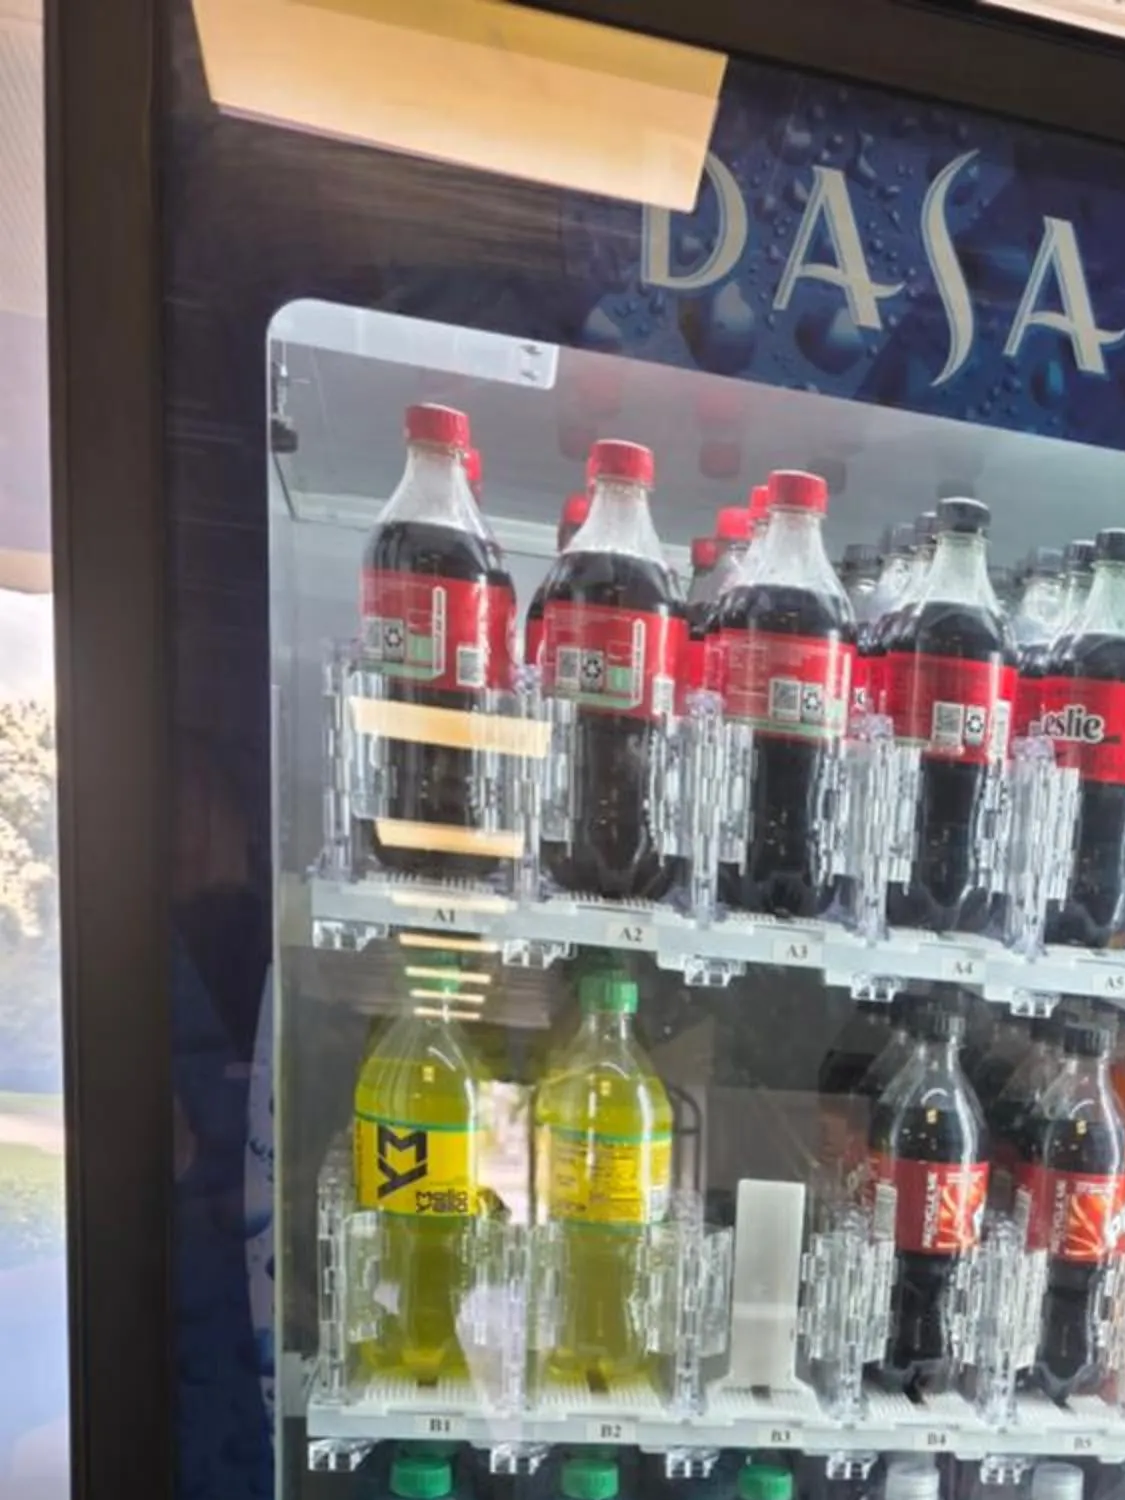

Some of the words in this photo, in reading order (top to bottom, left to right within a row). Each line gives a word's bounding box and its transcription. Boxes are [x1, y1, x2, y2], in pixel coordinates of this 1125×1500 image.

[1030, 704, 1105, 744] eslie
[433, 909, 455, 922] A1
[620, 930, 643, 942] A2
[786, 946, 807, 958] A3
[953, 962, 972, 974] A4
[1105, 976, 1124, 989] A5
[430, 1421, 450, 1432] B1
[601, 1426, 621, 1437] B2
[771, 1432, 790, 1442] B3
[927, 1434, 946, 1445] B4
[1074, 1439, 1091, 1449] B5
